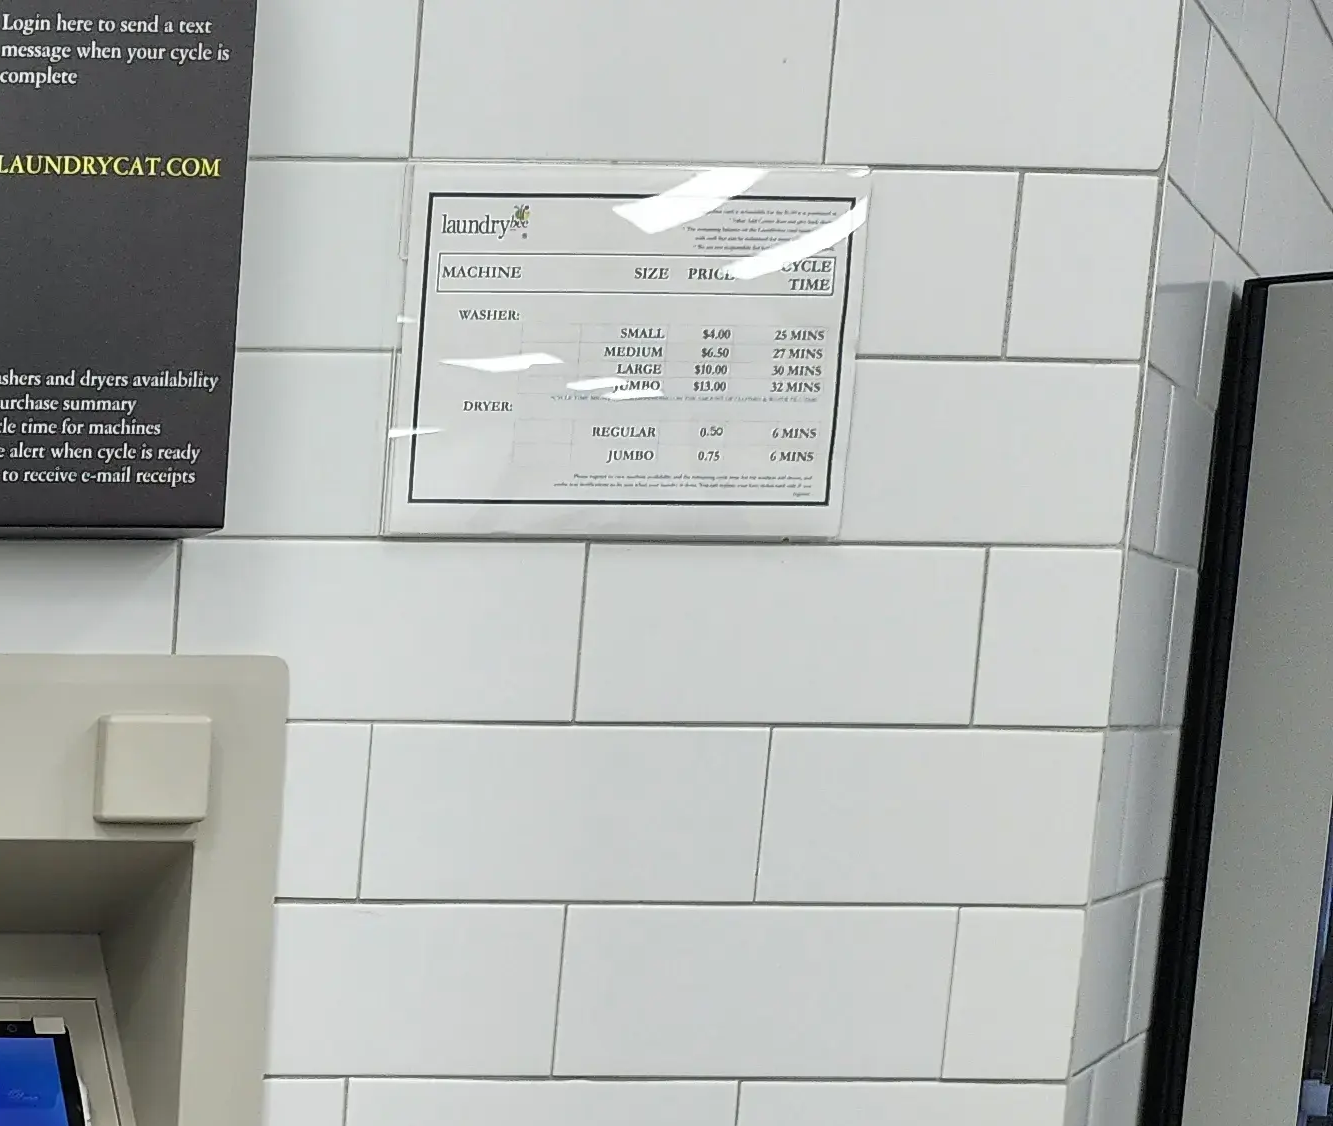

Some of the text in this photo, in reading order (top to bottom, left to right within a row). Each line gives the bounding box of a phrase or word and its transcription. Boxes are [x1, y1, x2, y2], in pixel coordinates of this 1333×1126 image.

[2, 13, 212, 35] Login here to send a text
[442, 265, 521, 278] MACHINE
[634, 267, 669, 279] SIZE
[788, 278, 830, 291] TIME
[459, 310, 520, 320] WASHER:
[621, 328, 824, 340] SMALL $4.00 25 MINS
[604, 347, 823, 359] MEDIUM $6.50 27 MINS
[617, 364, 822, 376] LARGE $10.00 30 MINS
[463, 401, 512, 411] DRYER:
[592, 426, 816, 439] REGULAR 0.50 6 MINS
[3, 470, 18, 481] to
[23, 467, 77, 482] receive
[82, 467, 130, 482] e-mail
[136, 467, 195, 487] receipts
